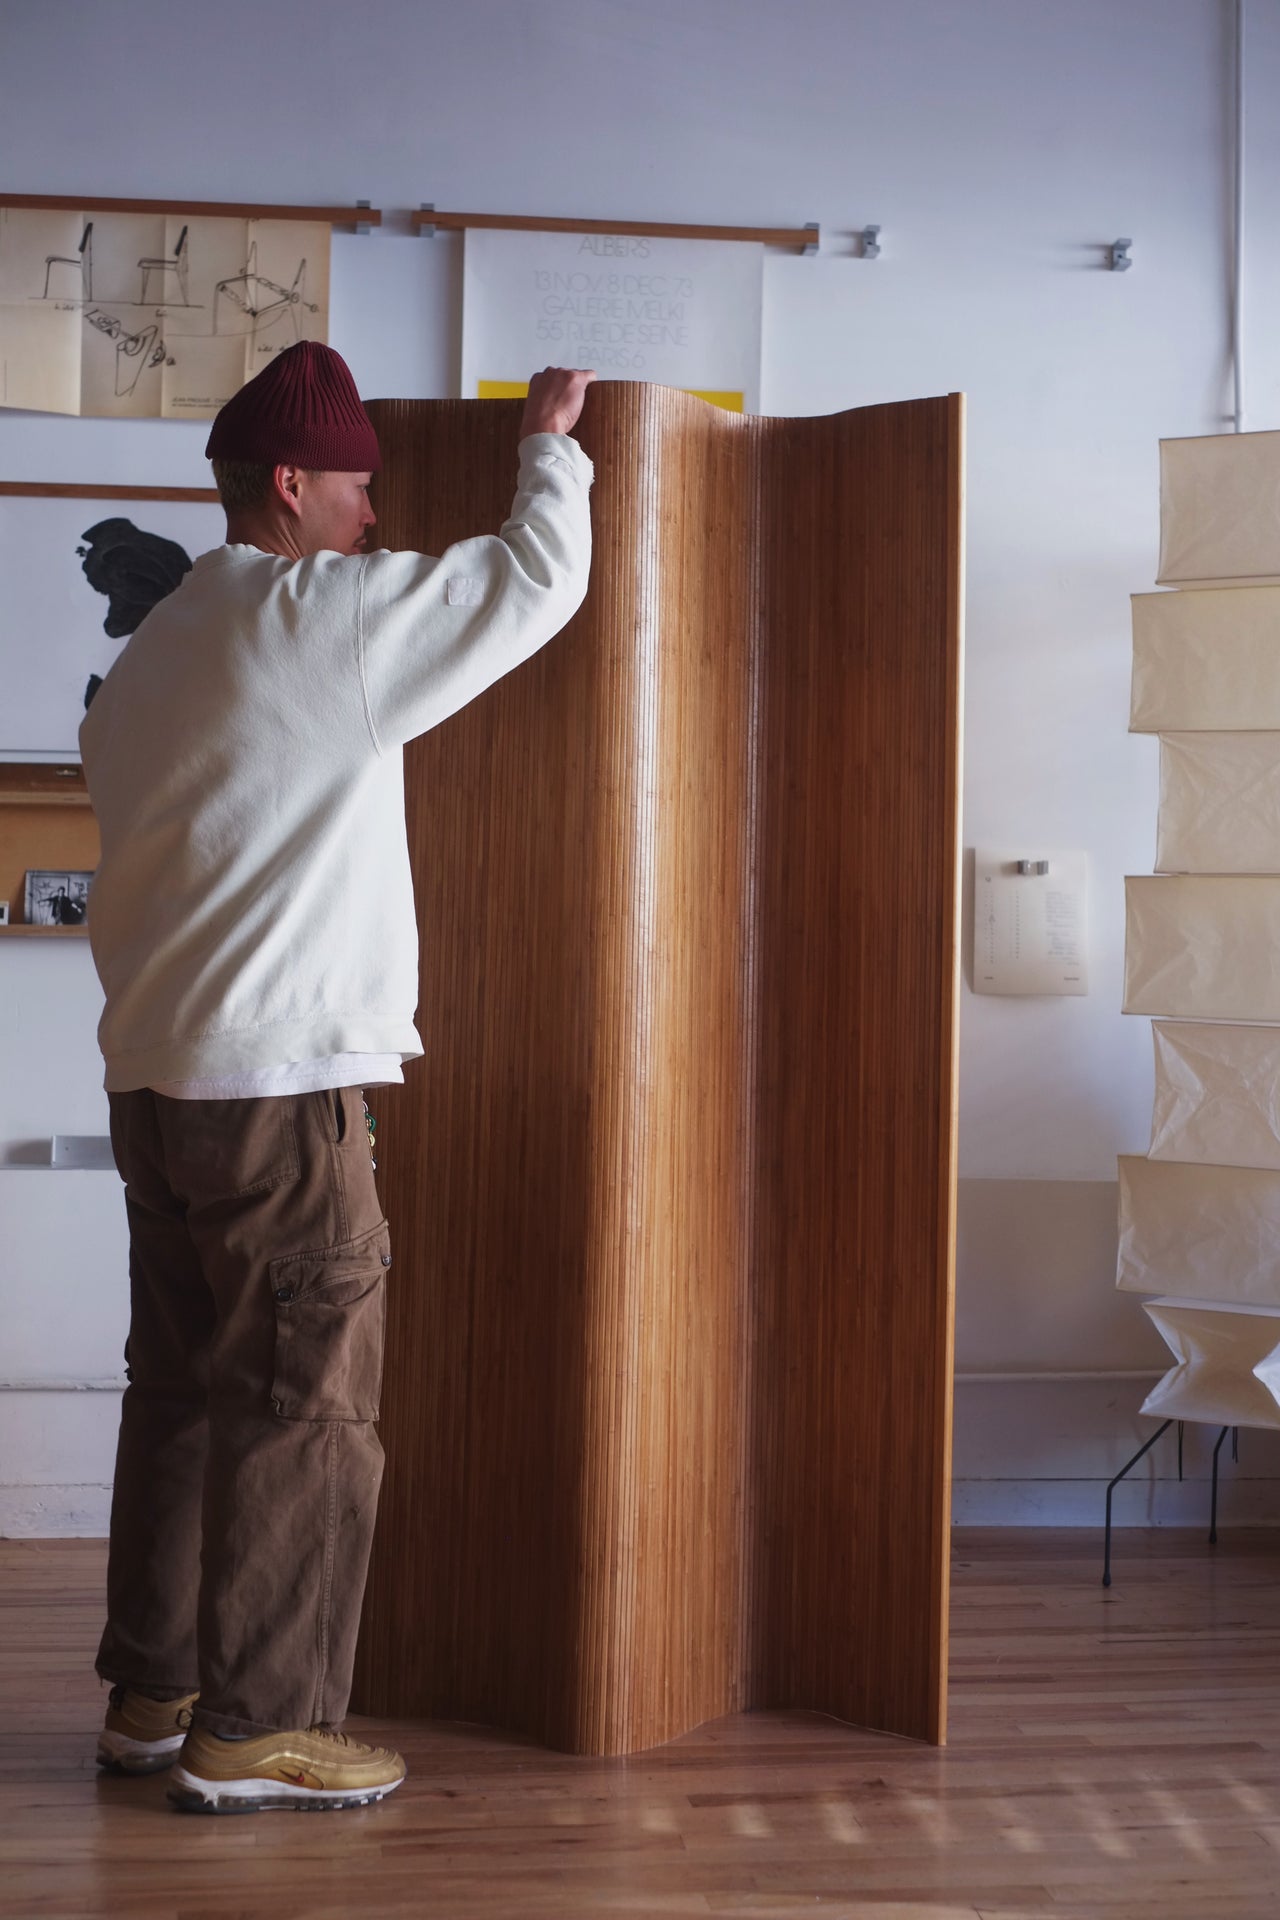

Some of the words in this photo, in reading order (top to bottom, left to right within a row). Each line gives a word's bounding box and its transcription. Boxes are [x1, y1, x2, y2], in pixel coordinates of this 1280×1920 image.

[577, 236, 650, 259] ALBERS
[534, 271, 551, 292] 13
[607, 274, 620, 294] 8
[674, 278, 694, 298] 73
[544, 295, 624, 319] GALERIE
[627, 300, 685, 321] MELKI
[536, 320, 564, 341] 55
[567, 321, 603, 343] RUE
[608, 323, 634, 344] DE
[638, 325, 688, 348] SEINE
[577, 346, 630, 369] PARIS
[632, 351, 646, 369] 6
